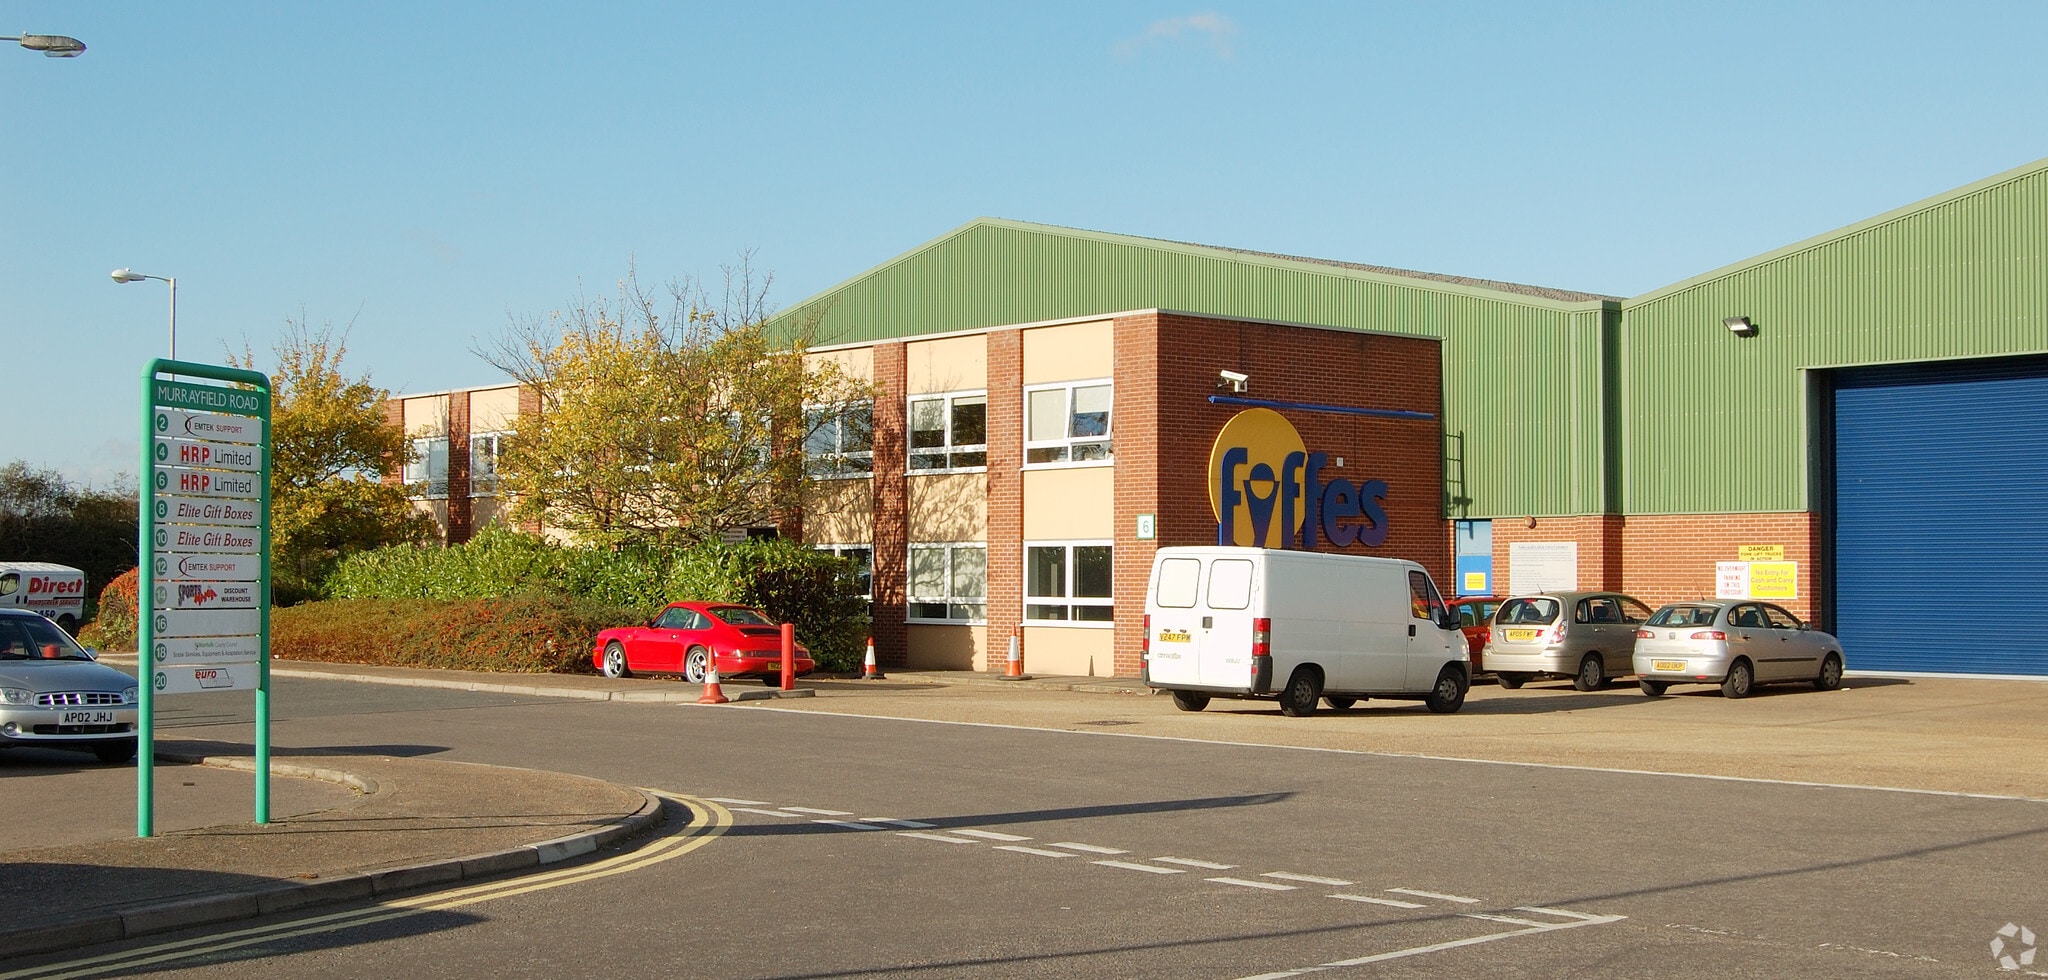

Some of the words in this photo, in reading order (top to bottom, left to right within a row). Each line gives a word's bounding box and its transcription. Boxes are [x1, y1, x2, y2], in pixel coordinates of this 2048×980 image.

[158, 386, 227, 407] MURRAYFIELD
[229, 394, 259, 411] ROAD
[160, 417, 166, 429] 2
[194, 422, 214, 432] EMTEK
[216, 424, 242, 434] SUPPORT
[159, 447, 166, 459] 4
[180, 445, 210, 464] HRP
[214, 448, 252, 466] Limited
[159, 474, 165, 486] 6
[180, 473, 210, 492] HRP
[214, 476, 252, 493] Limited
[158, 503, 165, 515] 8
[177, 503, 201, 519] Elite
[203, 504, 222, 519] Gift
[223, 505, 253, 520] Boxes
[1143, 520, 1149, 533] 6
[157, 532, 166, 543] 10
[177, 531, 201, 546] Elite
[203, 532, 222, 547] Gift
[223, 533, 253, 548] Boxes
[157, 559, 166, 574] 12
[188, 563, 208, 571] EMTEK
[209, 563, 236, 572] SUPPORT
[28, 576, 83, 593] Direct
[224, 587, 248, 595] DISCOUNT
[157, 588, 166, 602] 14
[178, 584, 202, 607] SPORTS
[156, 617, 166, 630] 16
[156, 645, 165, 659] 18
[156, 676, 166, 687] 20
[195, 670, 217, 680] euro
[64, 713, 91, 723] AP02
[93, 712, 113, 722] JHJ
